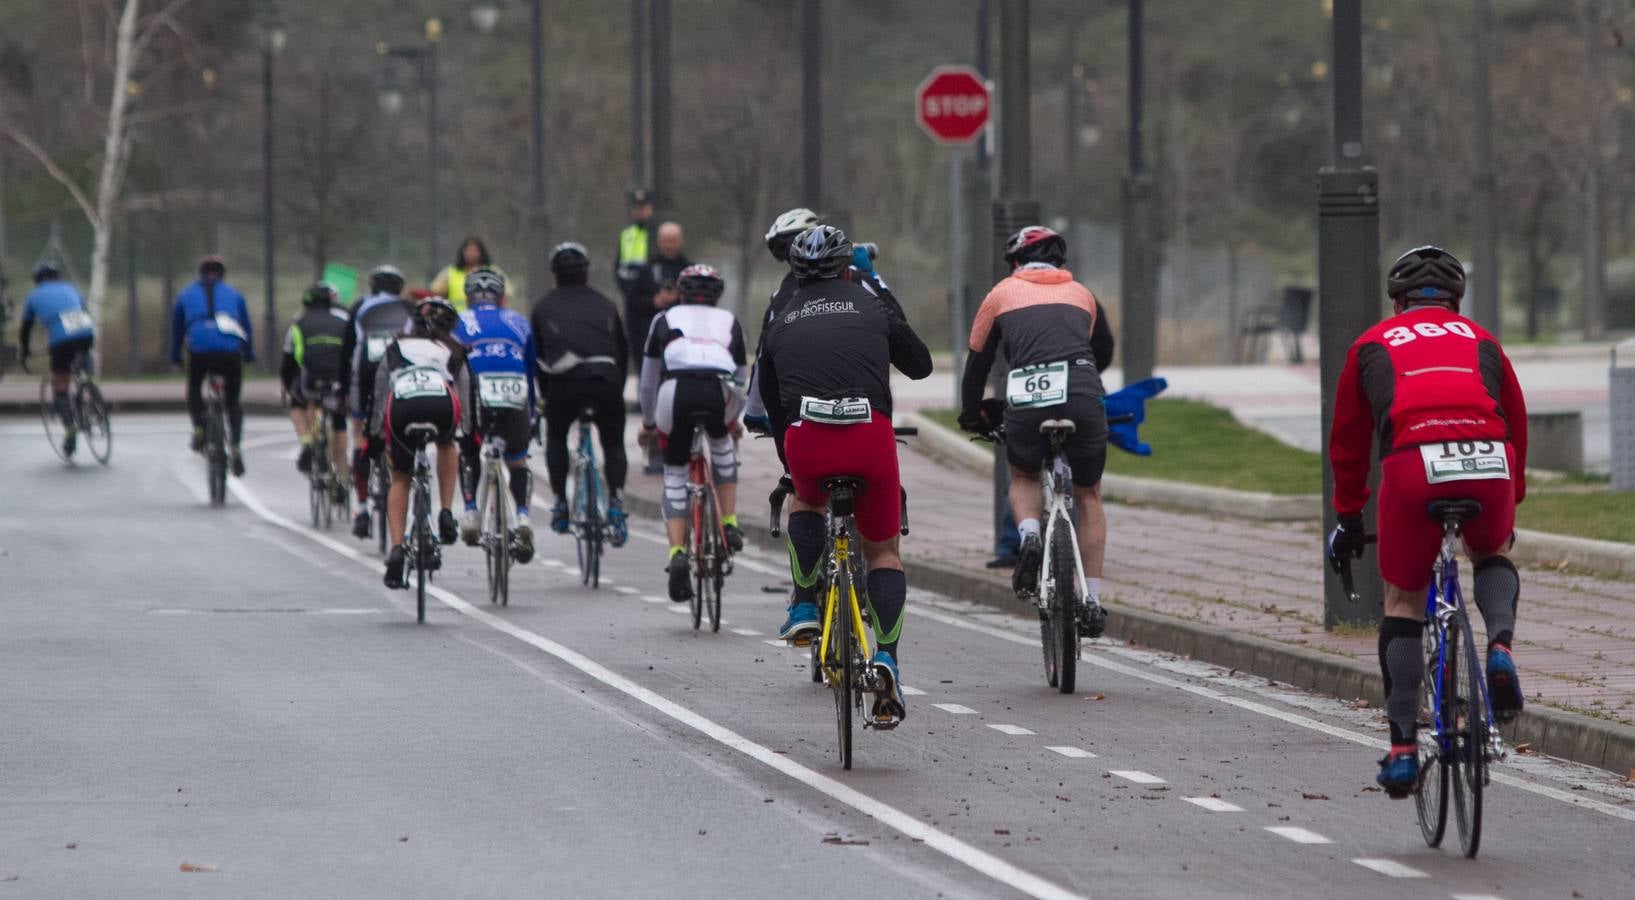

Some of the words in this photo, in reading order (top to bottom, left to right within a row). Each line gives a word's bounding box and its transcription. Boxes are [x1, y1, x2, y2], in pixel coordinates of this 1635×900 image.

[924, 94, 986, 118] STOP
[800, 301, 855, 317] PROFISEGUR
[1383, 321, 1476, 347] 360
[489, 379, 522, 396] 160
[1024, 374, 1051, 393] 66
